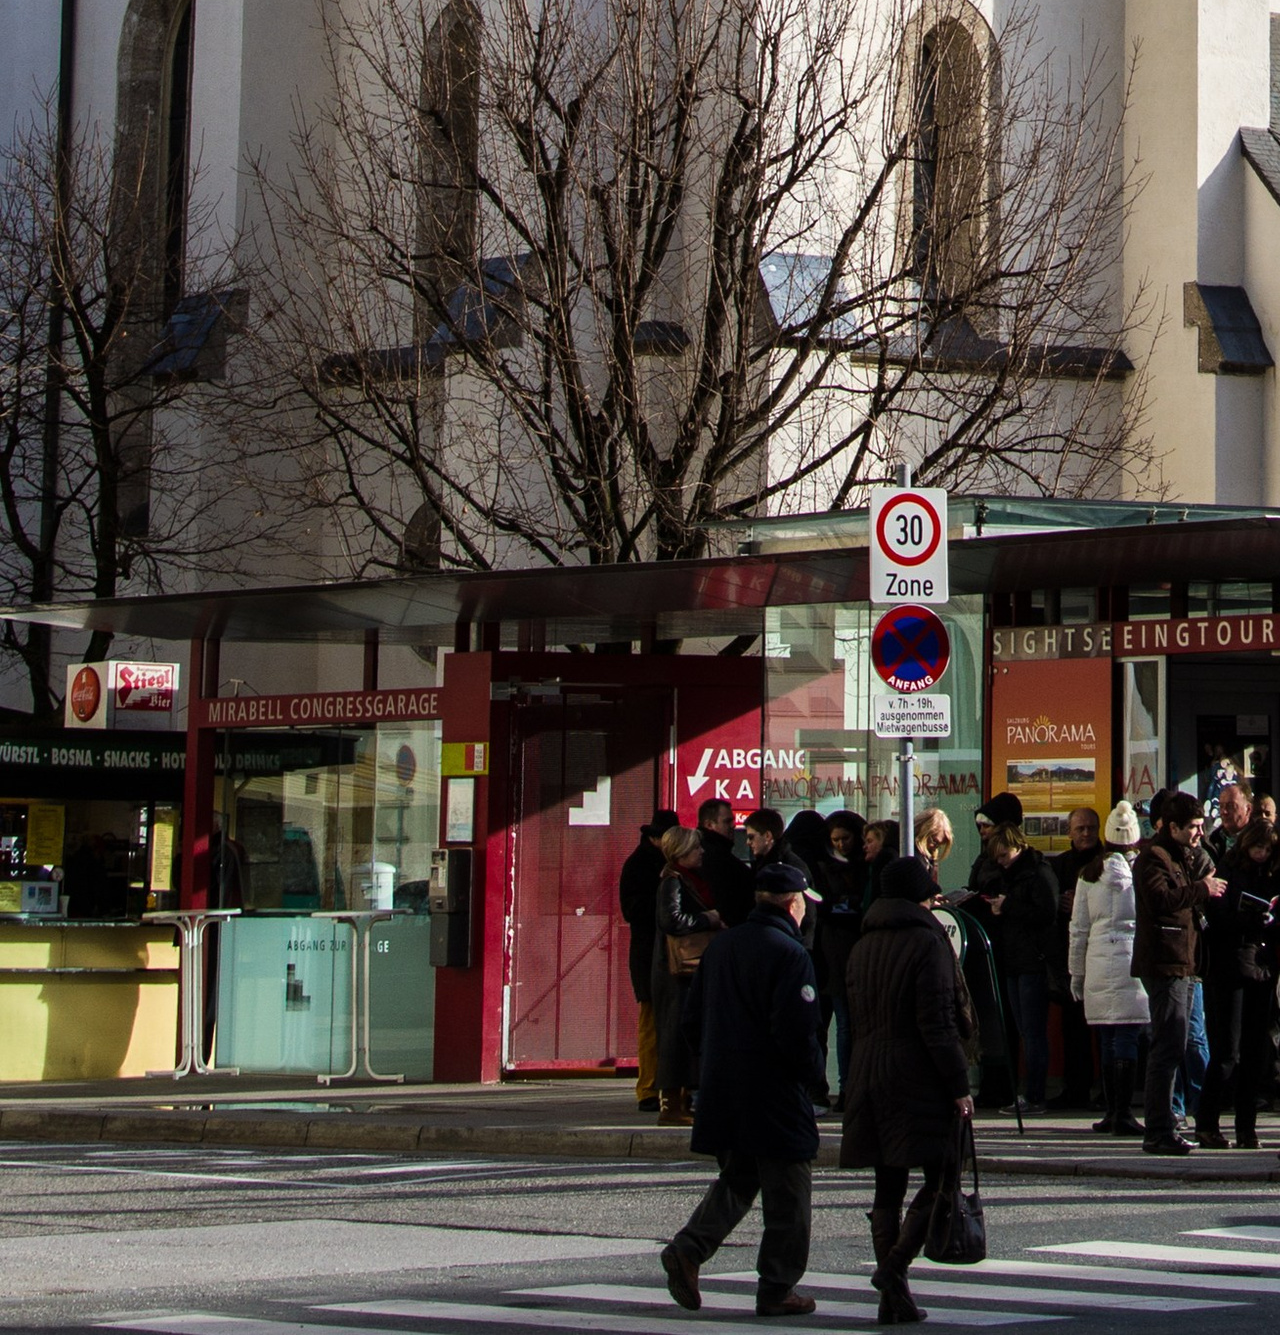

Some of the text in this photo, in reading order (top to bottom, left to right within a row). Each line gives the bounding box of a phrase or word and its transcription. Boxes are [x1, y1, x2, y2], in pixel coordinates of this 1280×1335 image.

[895, 514, 923, 546] 30
[886, 573, 933, 596] Zone
[118, 666, 171, 695] Stiegl
[887, 675, 934, 691] ANFANG
[149, 694, 171, 708] Bier
[208, 693, 438, 722] MIRABELL CONGRESSGARAGE
[898, 698, 908, 709] 7h
[880, 711, 944, 724] ausgenommen
[877, 721, 949, 736] Mietwagenbusse
[1006, 723, 1096, 744] PANORAMA
[51, 747, 93, 767] BOSNA
[104, 750, 150, 769] SNACKS
[162, 752, 186, 769] HOT
[235, 752, 281, 770] DRINKS
[287, 939, 325, 951] ABGANG
